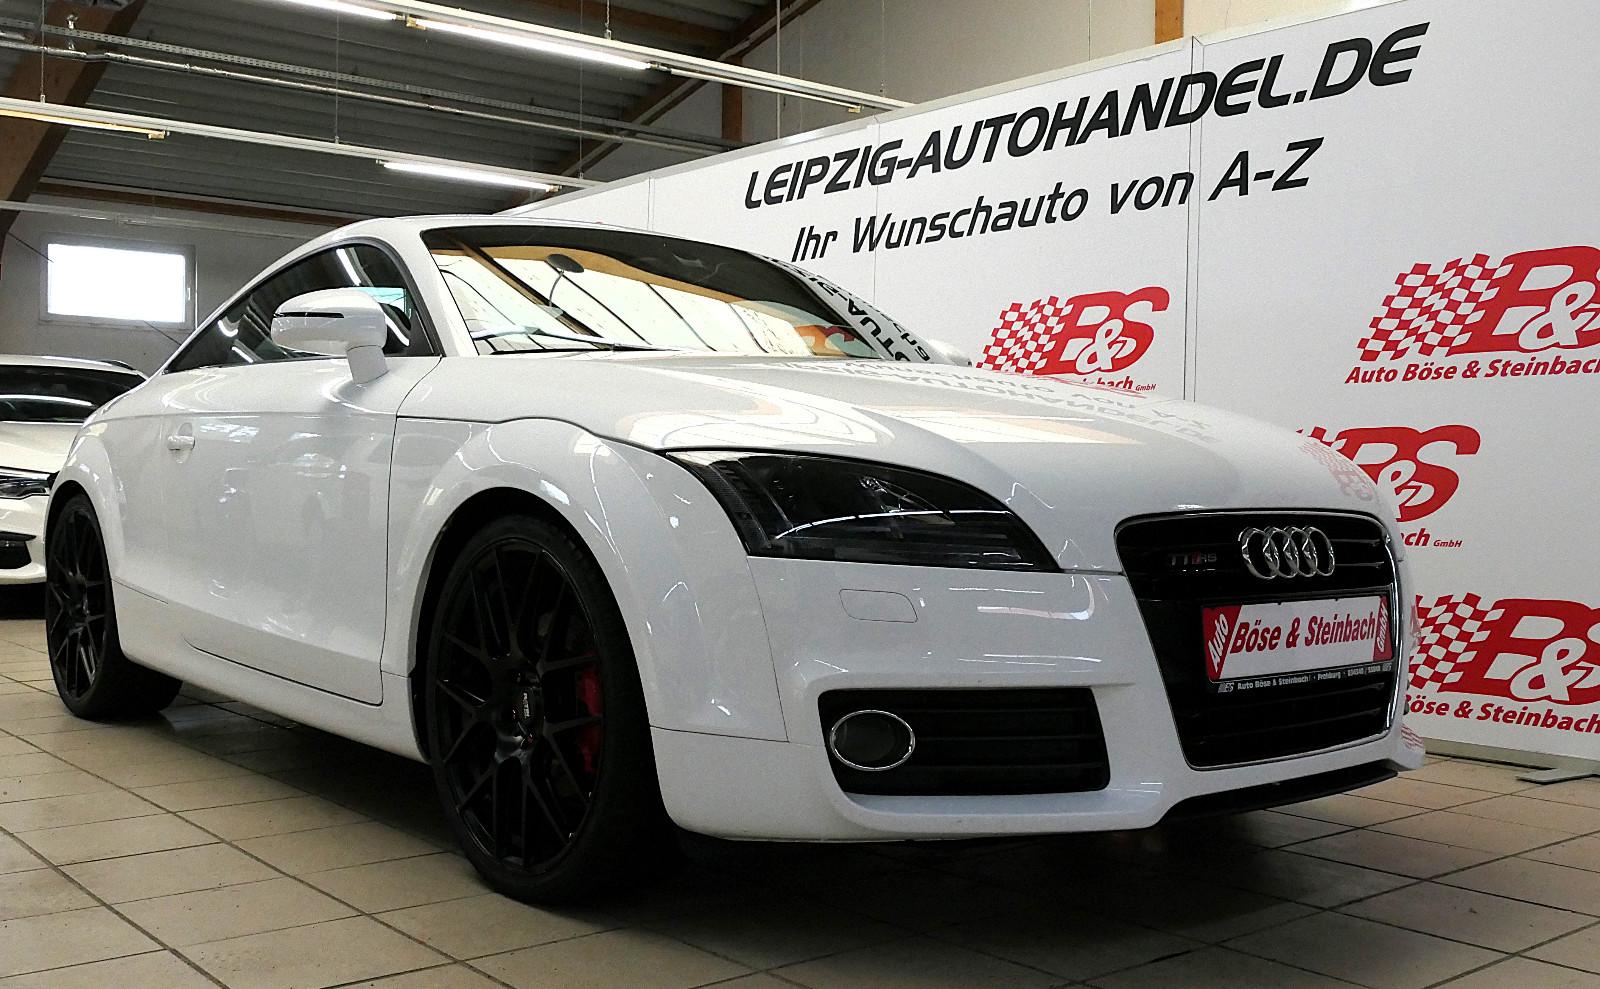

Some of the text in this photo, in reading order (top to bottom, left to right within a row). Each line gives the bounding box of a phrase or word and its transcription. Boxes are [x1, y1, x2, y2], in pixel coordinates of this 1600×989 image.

[744, 22, 1430, 209] LEIPZIG-AUTOHANDEL.DE
[791, 137, 1324, 263] Ihr Wunschauto von A-Z
[1344, 355, 1600, 384] Auto Böse & Steinbac
[1433, 539, 1463, 548] GmbH
[1207, 613, 1230, 673] Auto
[1230, 611, 1376, 654] Böse & Steinbach
[1406, 695, 1449, 716] öse
[1454, 700, 1474, 719] &
